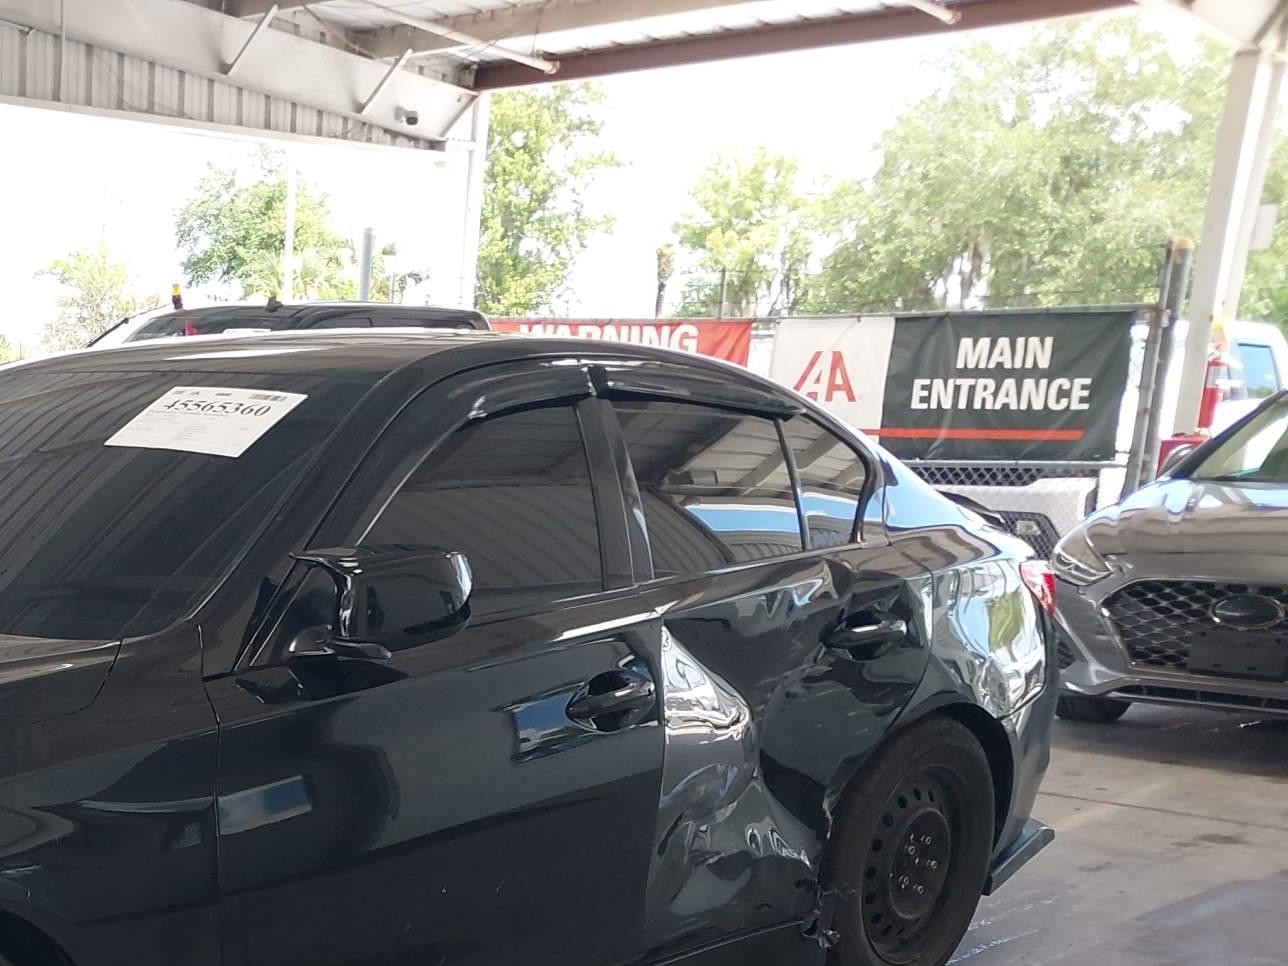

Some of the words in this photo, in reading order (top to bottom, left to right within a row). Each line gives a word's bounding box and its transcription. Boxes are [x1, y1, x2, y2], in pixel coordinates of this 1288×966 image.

[955, 336, 1054, 369] MAIN
[163, 399, 272, 417] 45565360
[910, 377, 1093, 411] ENTRANCE
